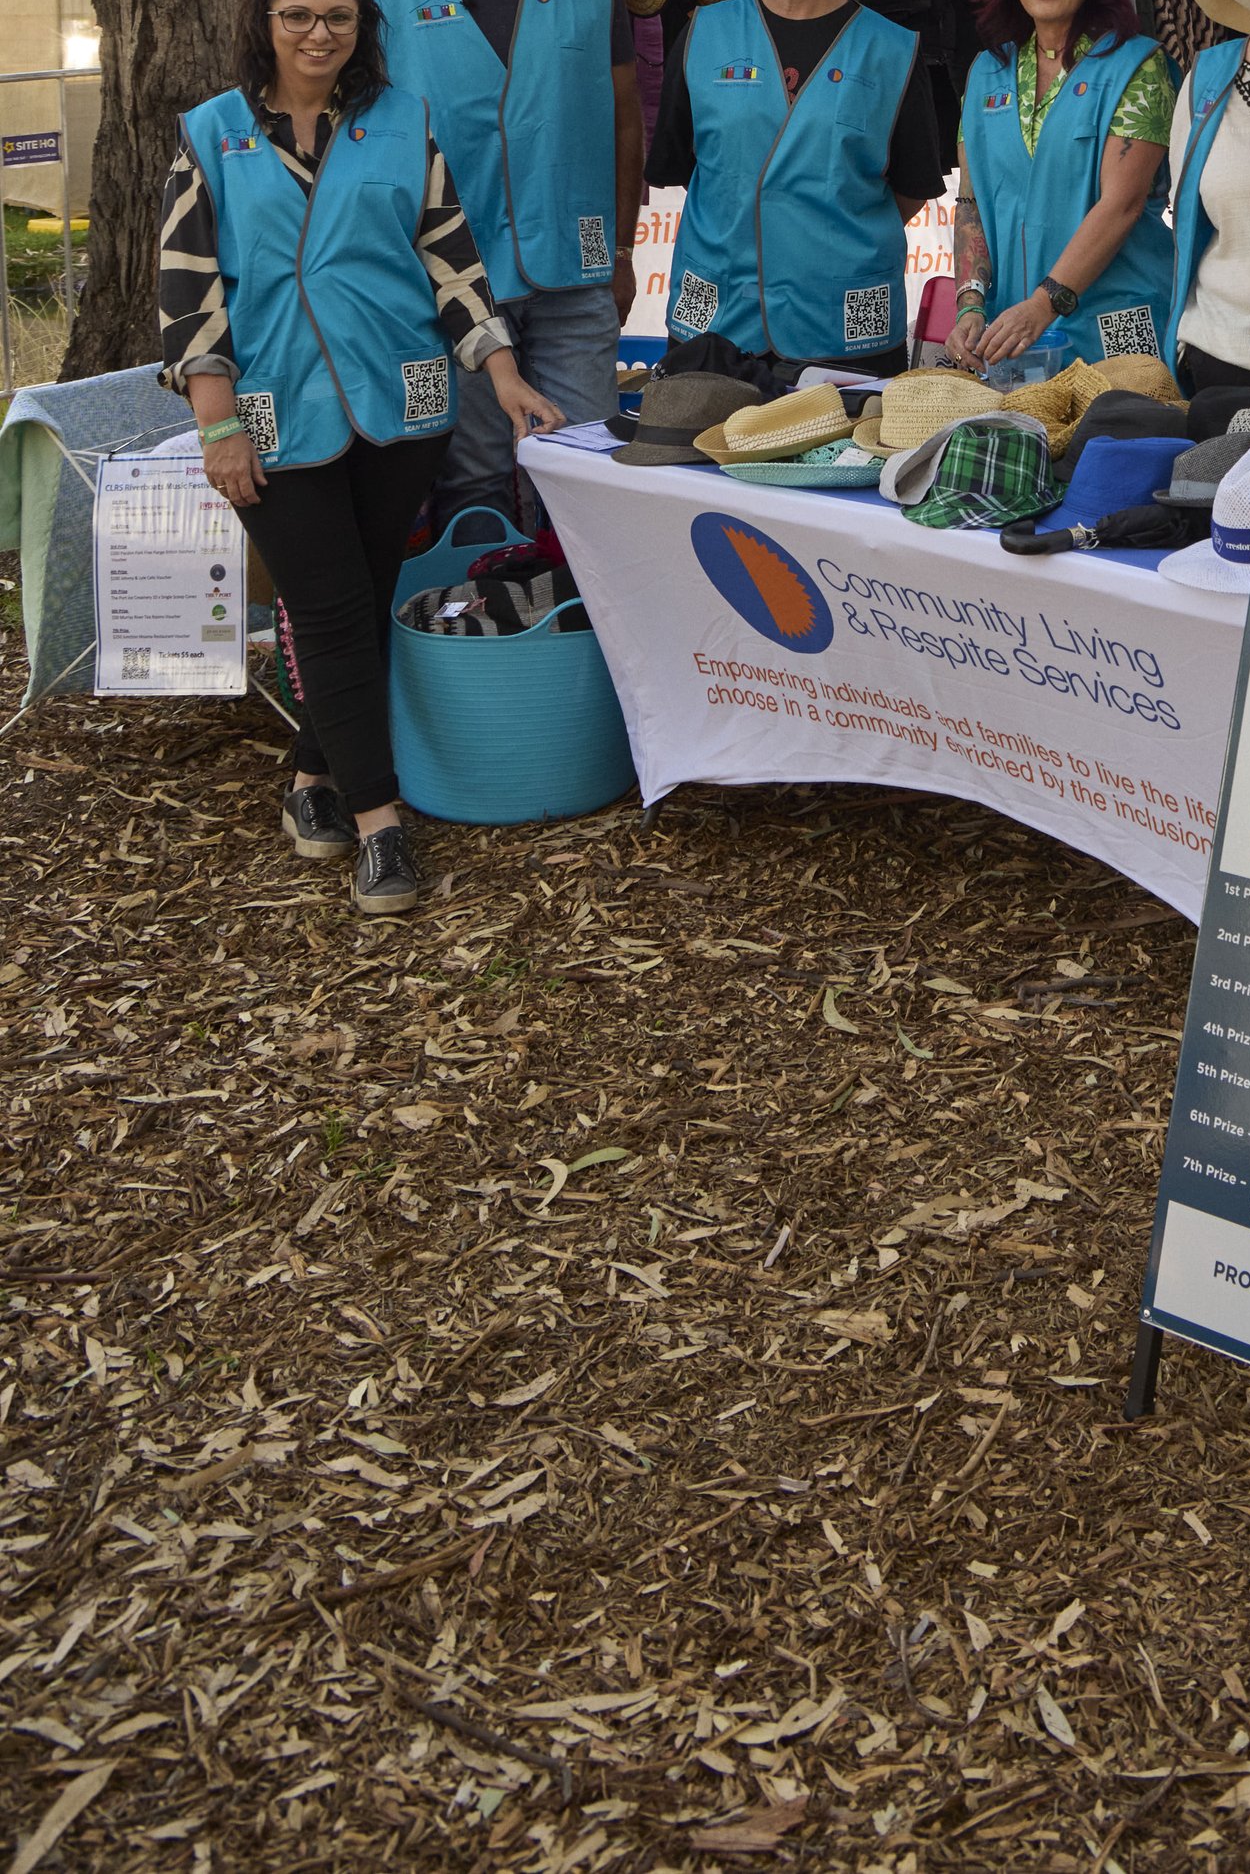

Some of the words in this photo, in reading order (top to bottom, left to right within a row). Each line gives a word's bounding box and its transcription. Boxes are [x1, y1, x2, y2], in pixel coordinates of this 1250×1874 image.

[16, 140, 38, 151] SITE
[39, 138, 56, 149] HQ
[817, 557, 1028, 647] Community
[1039, 612, 1165, 688] Living
[846, 601, 871, 637] &
[878, 609, 1010, 677] Respite
[1013, 647, 1181, 731] Services
[693, 652, 817, 699] Empowering
[818, 676, 932, 720] individuals
[936, 710, 974, 737] and
[976, 721, 1063, 768] families
[1067, 752, 1090, 777] to
[1095, 760, 1135, 795] live
[1141, 780, 1179, 812] the
[1184, 796, 1216, 830] life
[707, 684, 778, 712] choose
[783, 693, 802, 718] in
[808, 704, 821, 722] a
[825, 709, 938, 752] community
[945, 734, 1034, 783] enriched
[1039, 765, 1065, 797] by
[1070, 780, 1107, 811] the
[1113, 794, 1213, 855] inclusion
[1224, 882, 1240, 897] 1st
[1216, 928, 1240, 944] 2nd
[1209, 974, 1231, 991] 3rd
[1203, 1020, 1224, 1037] 4th
[1196, 1062, 1217, 1078] 5th
[1220, 1068, 1250, 1089] Prize
[1189, 1109, 1211, 1126] 6th
[1213, 1115, 1245, 1137] Prize
[1182, 1156, 1203, 1173] 7th
[1205, 1164, 1237, 1185] Prize
